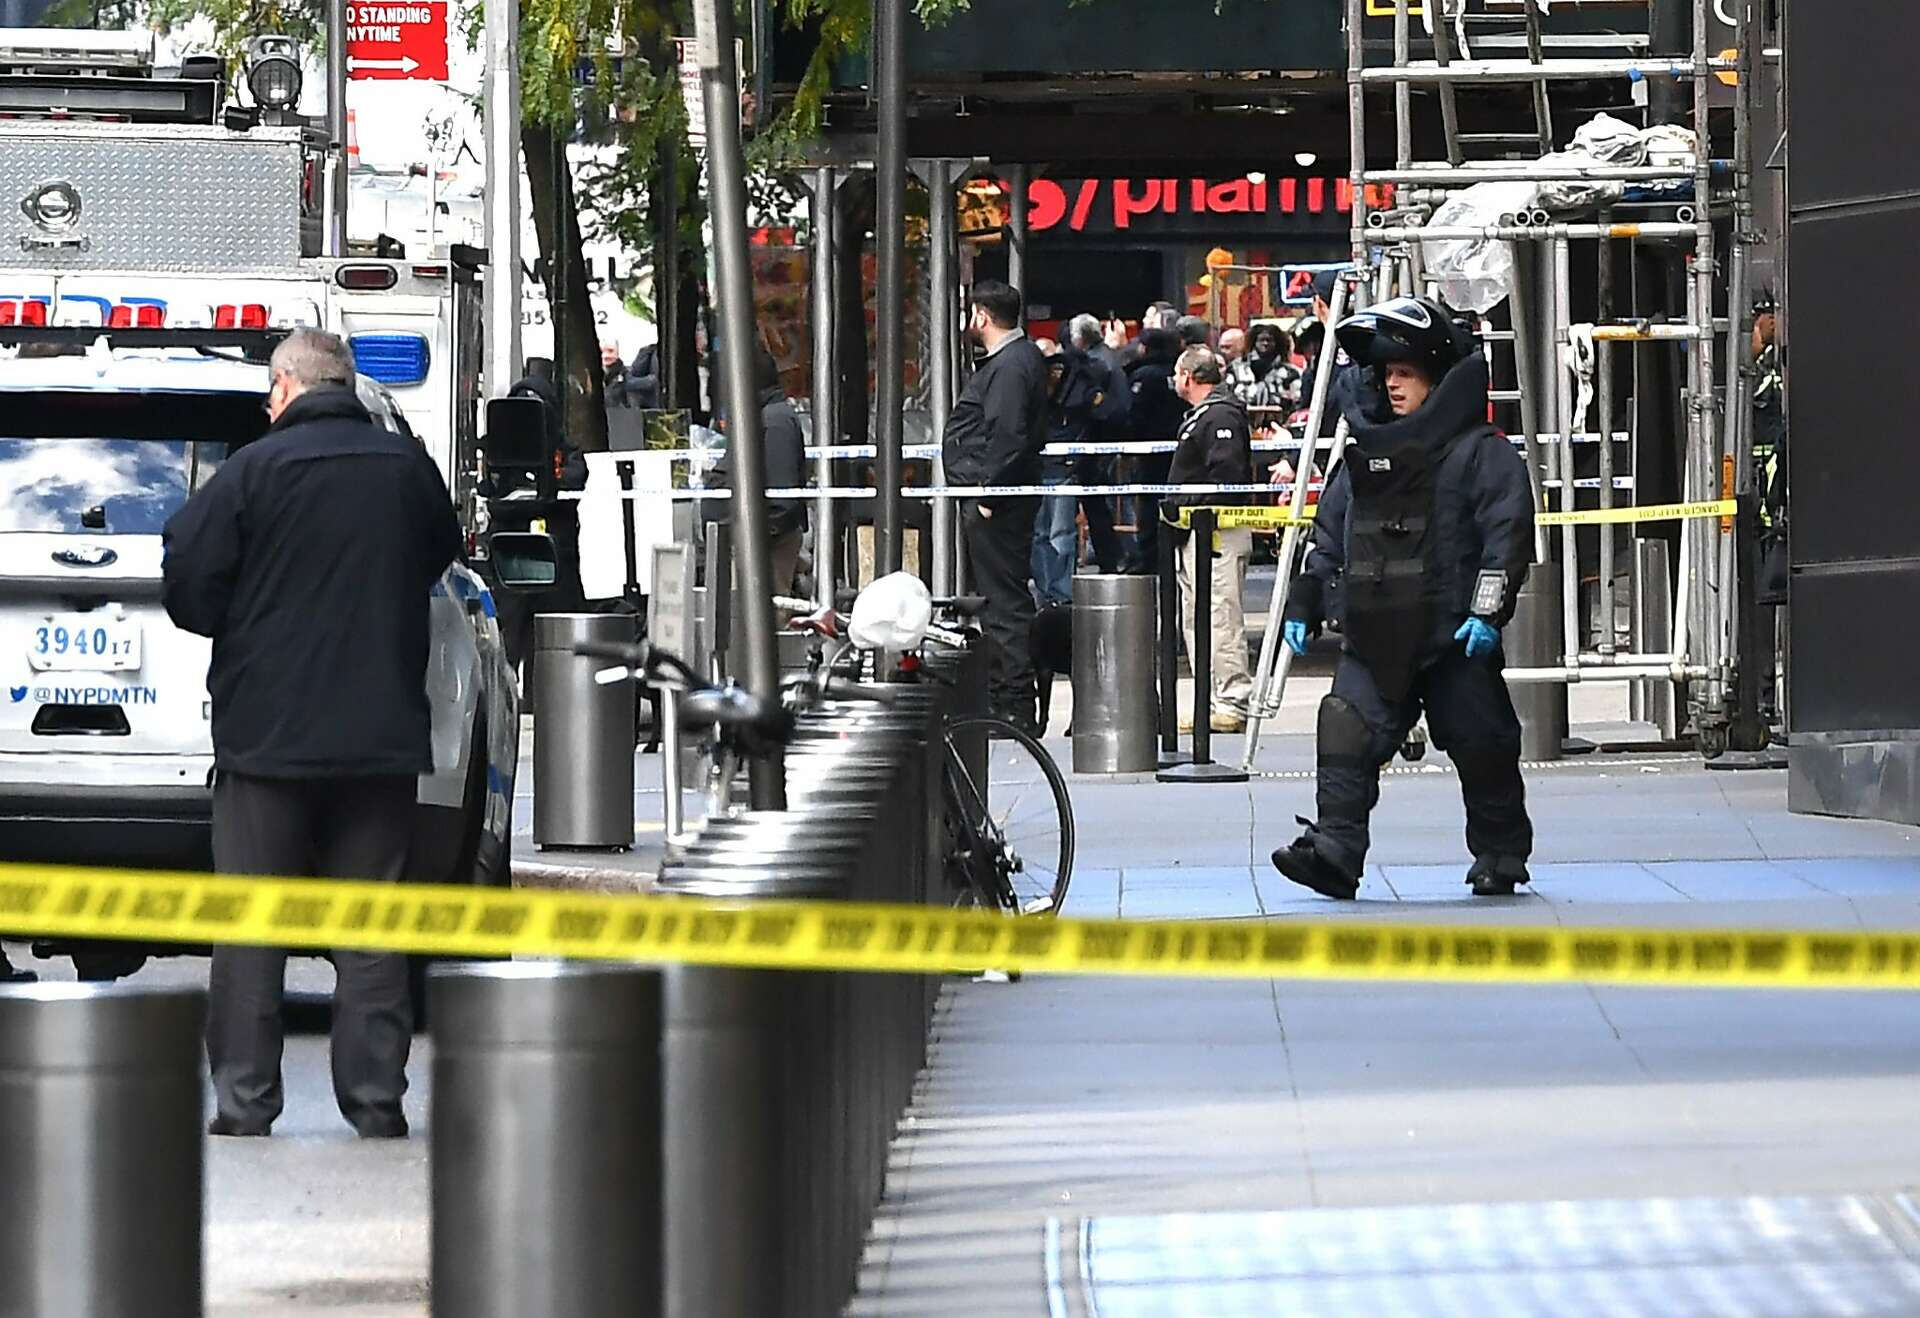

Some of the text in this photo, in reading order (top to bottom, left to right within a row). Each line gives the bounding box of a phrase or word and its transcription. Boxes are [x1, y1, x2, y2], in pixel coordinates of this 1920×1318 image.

[346, 7, 431, 24] O STANDING
[347, 26, 400, 42] NYTIME
[36, 627, 107, 655] 3940
[34, 687, 157, 704] @NYPDMTN
